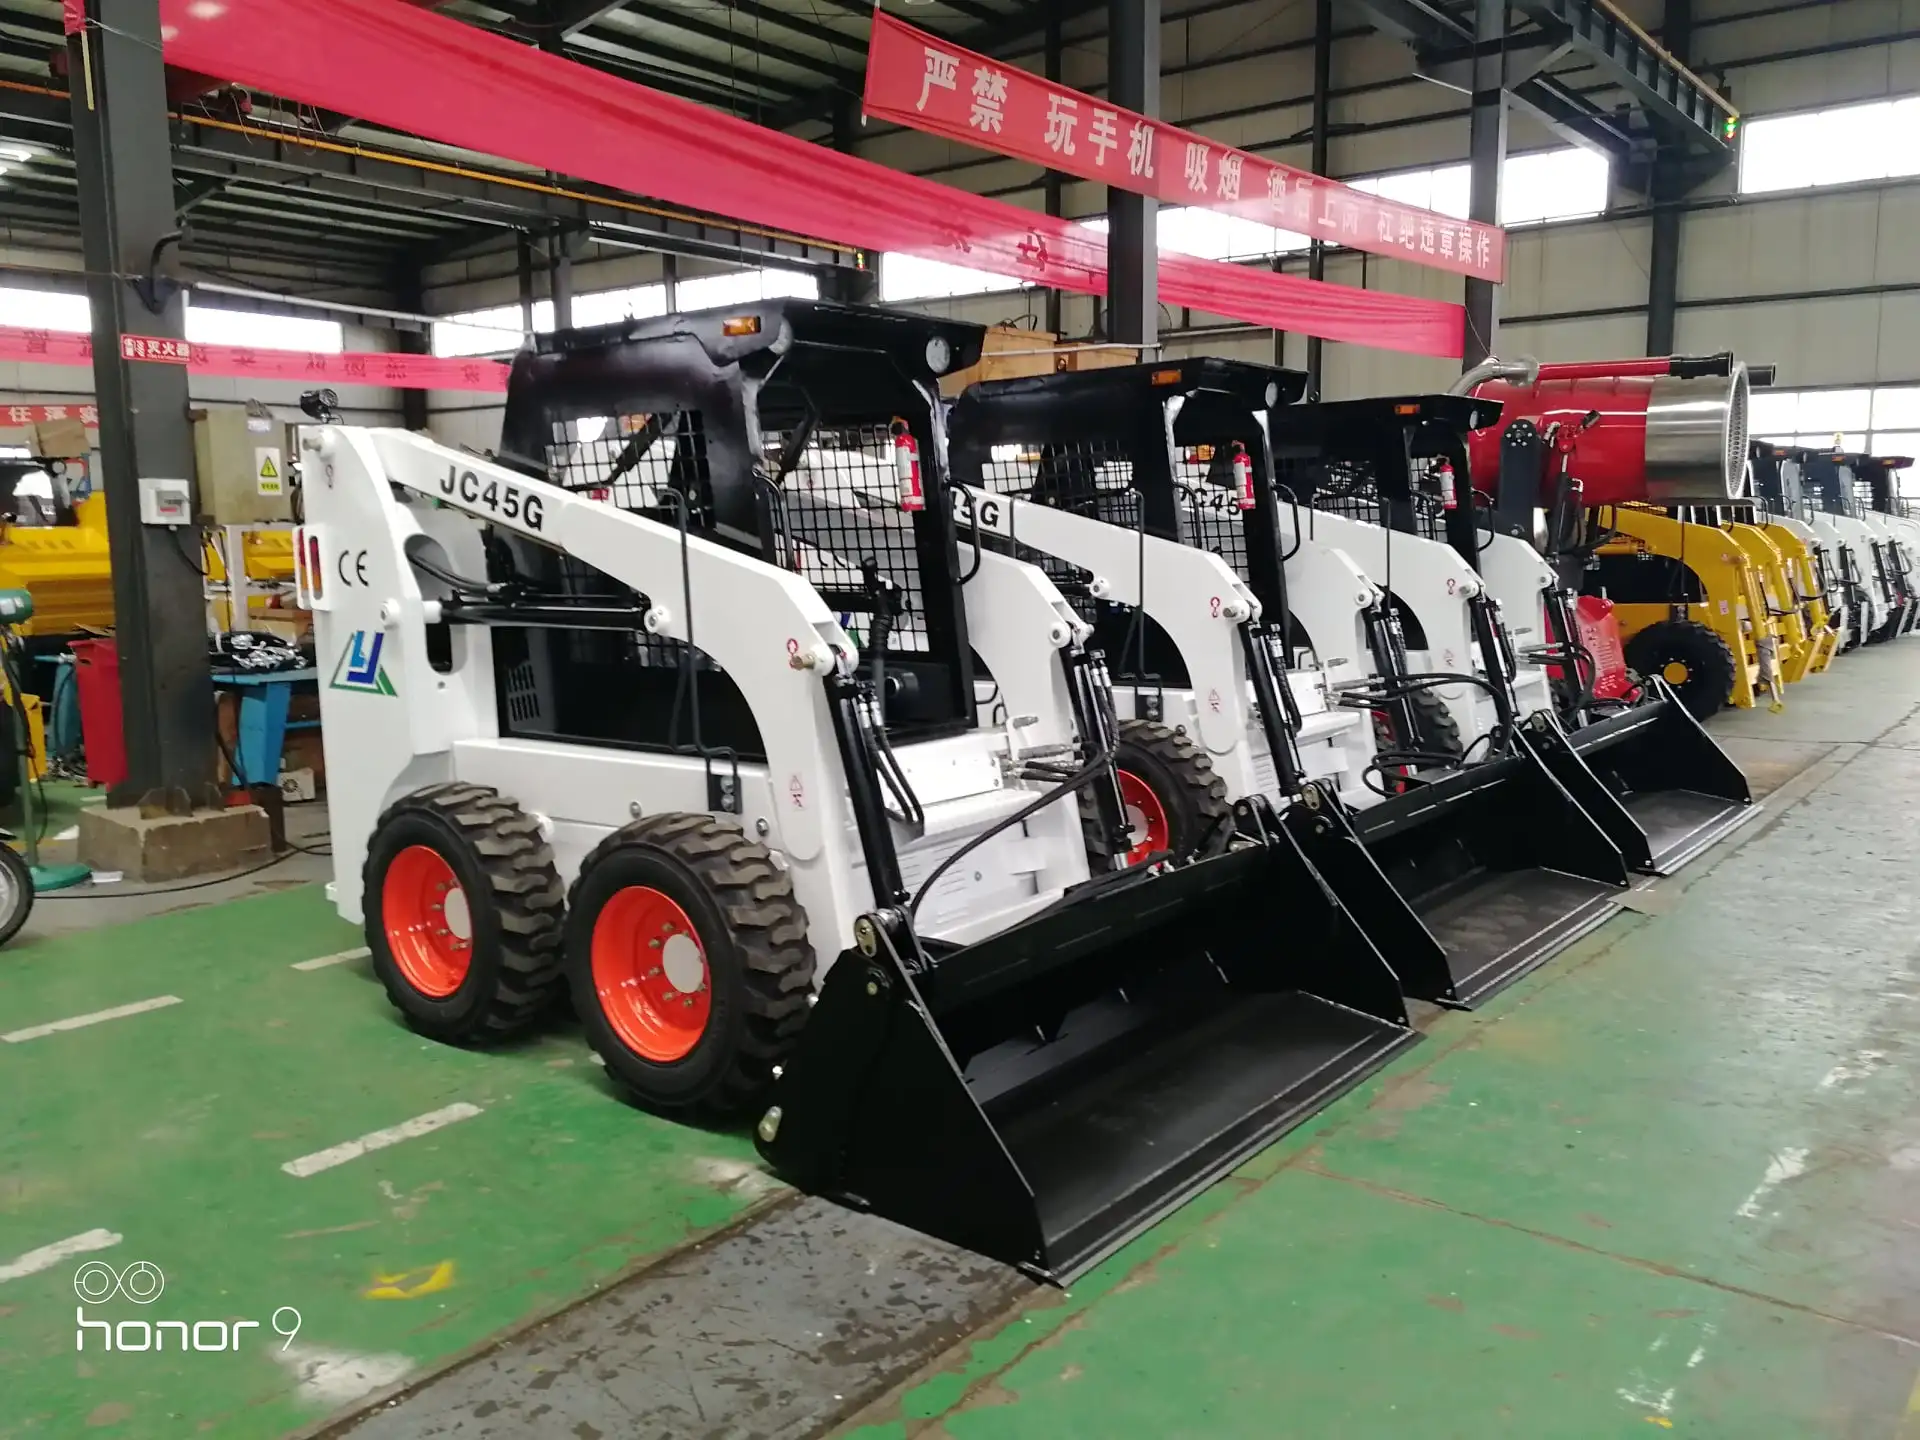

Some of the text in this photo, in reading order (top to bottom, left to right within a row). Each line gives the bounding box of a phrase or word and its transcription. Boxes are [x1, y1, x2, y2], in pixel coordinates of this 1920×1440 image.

[916, 46, 1008, 134] 严禁
[1044, 92, 1155, 178] 玩手机
[1184, 142, 1244, 201] 吸烟
[146, 340, 190, 357] 灭火器
[440, 465, 544, 531] JC45G
[338, 549, 369, 587] CE
